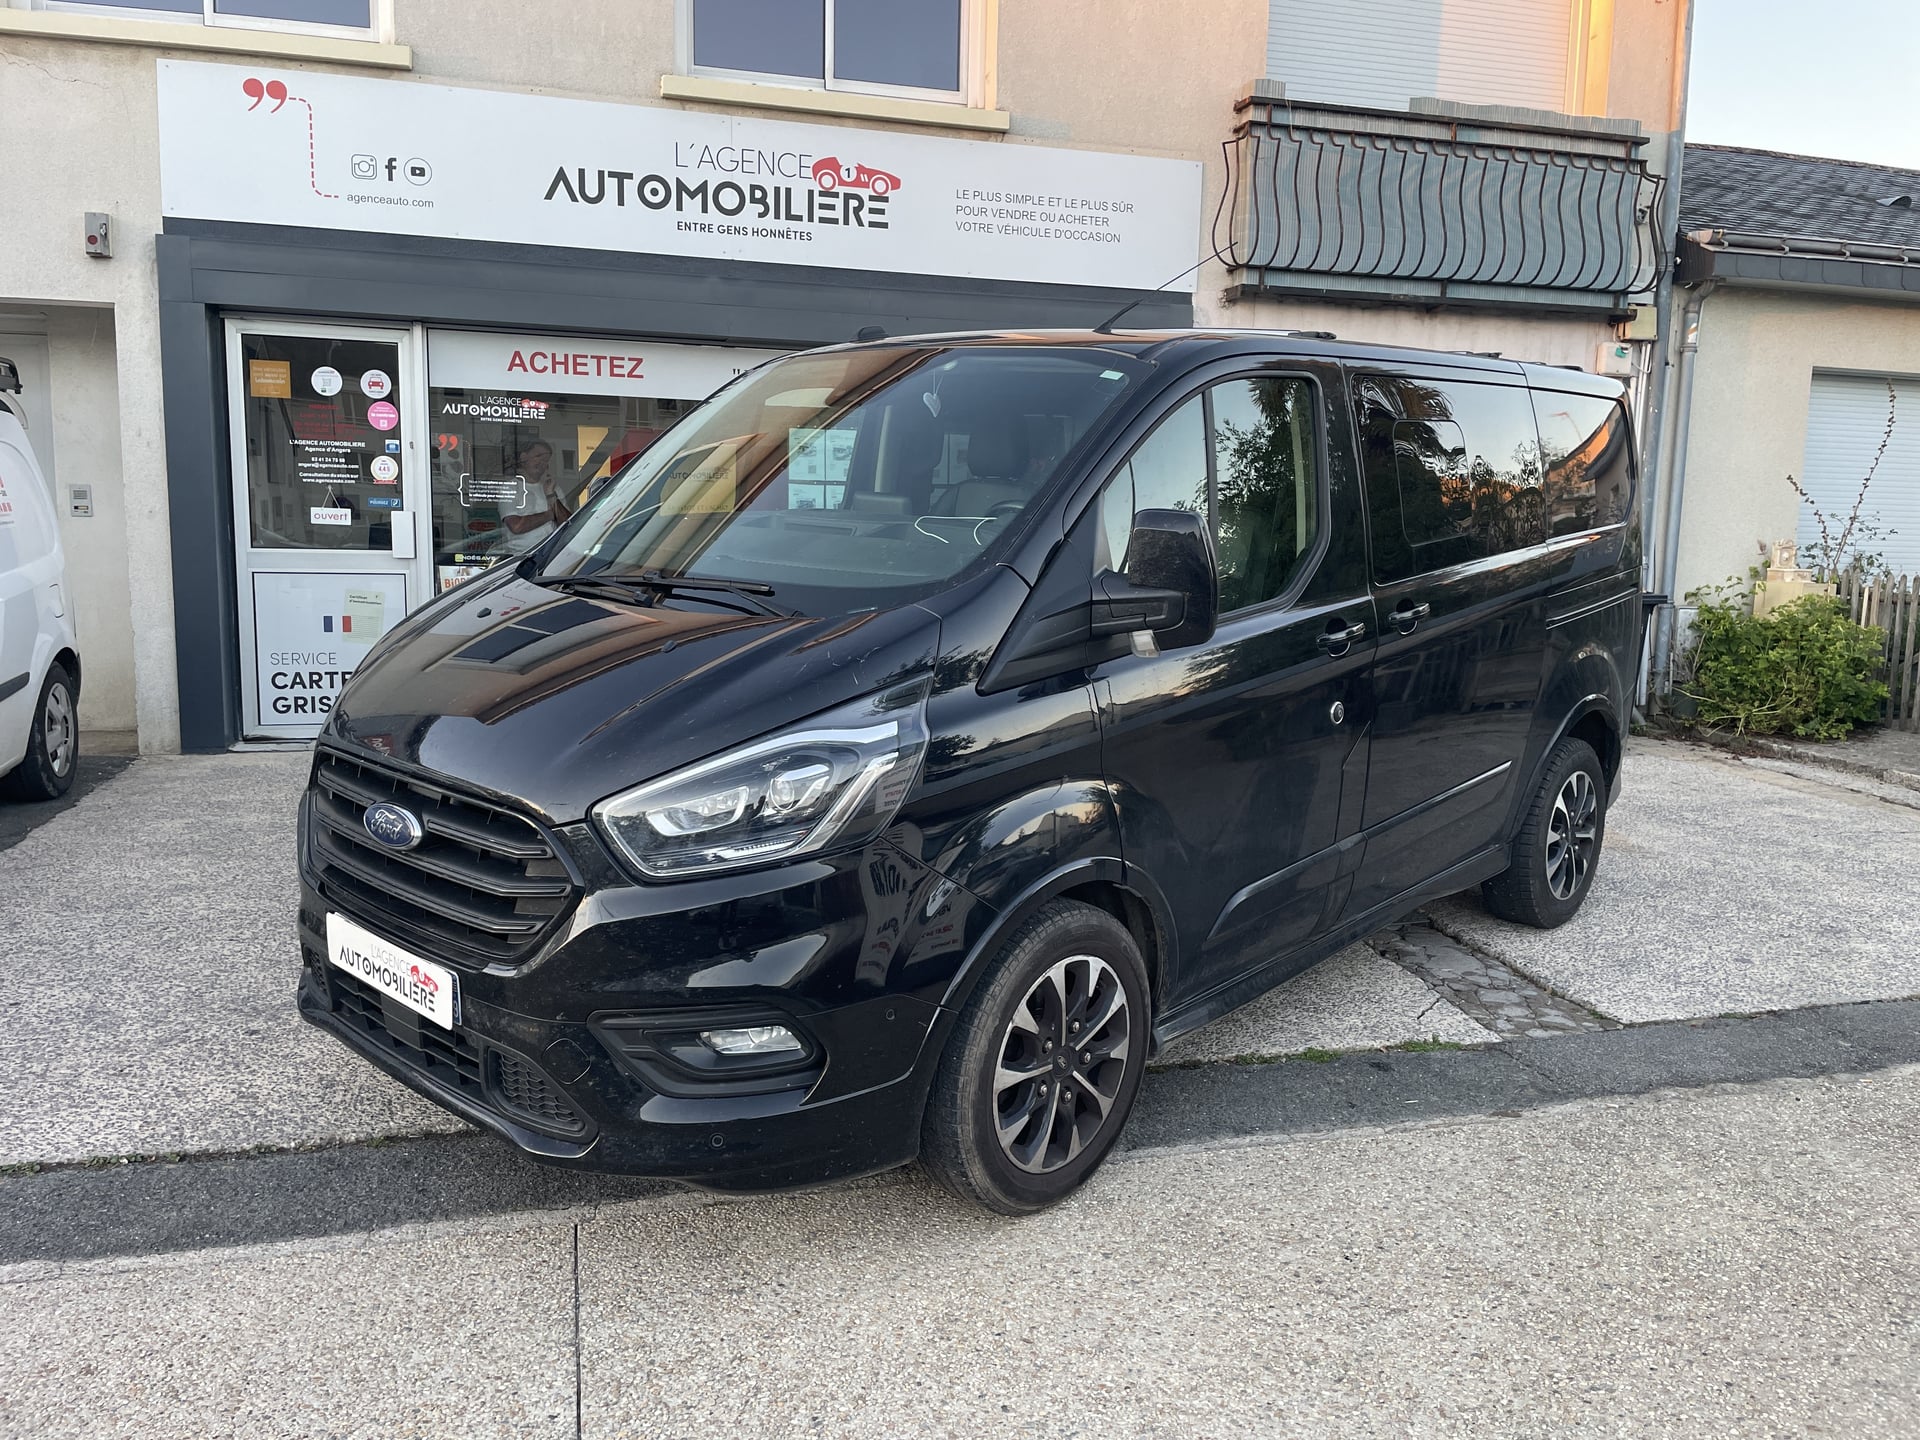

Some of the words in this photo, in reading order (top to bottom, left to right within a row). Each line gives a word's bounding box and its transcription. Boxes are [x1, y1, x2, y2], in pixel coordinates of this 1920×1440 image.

[675, 141, 813, 179] L'AGENCE
[346, 192, 435, 209] agenceauto.com
[956, 189, 970, 200] LE
[973, 190, 1002, 202] PLUS
[1005, 193, 1045, 206] SIMPLE
[1048, 196, 1062, 207] ET
[1064, 198, 1078, 208] LE
[1081, 199, 1109, 211] PLUS
[1111, 201, 1134, 213] SÛR
[956, 205, 988, 217] POUR
[991, 207, 1037, 221] VENDRE
[1039, 211, 1056, 222] OU
[1058, 213, 1110, 227] ACHETER
[677, 221, 714, 233] ENTRE
[717, 224, 749, 236] GENS
[751, 227, 813, 241] HONNÊTES
[955, 221, 994, 233] VOTRE
[997, 224, 1051, 238] VÉHICULE
[1054, 228, 1121, 244] D'OCCASION
[507, 350, 644, 379] ACHETEZ
[479, 395, 522, 407] L'AGENCE
[326, 446, 351, 454] d'Angers
[313, 511, 348, 522] ouvert
[270, 652, 337, 666] SERVICE
[272, 695, 338, 714] GRIS
[371, 808, 402, 841] Ford
[370, 943, 412, 978] L'AGENCE
